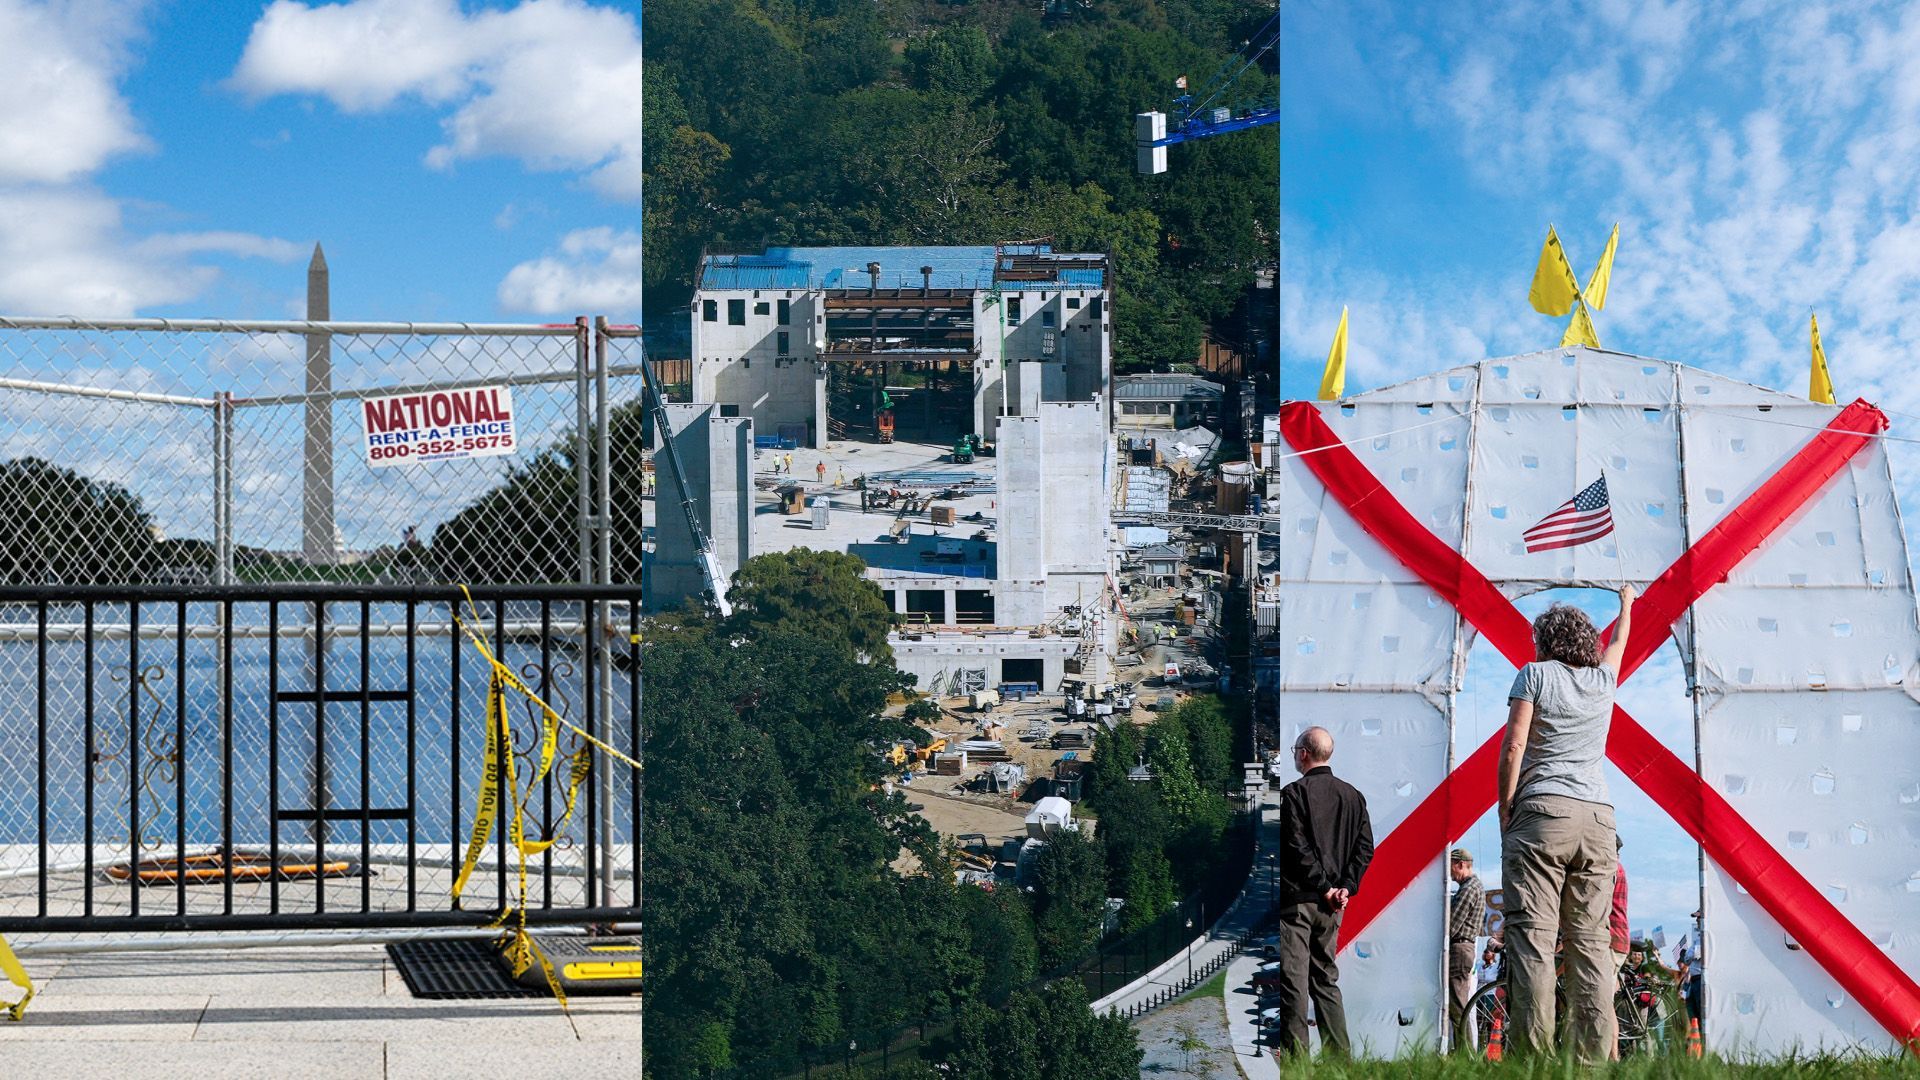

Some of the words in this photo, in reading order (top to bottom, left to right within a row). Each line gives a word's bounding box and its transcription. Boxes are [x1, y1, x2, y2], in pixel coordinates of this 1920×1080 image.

[364, 389, 510, 433] NATIONAL
[369, 421, 511, 446] RENT-A-FENCE
[370, 435, 513, 460] 800-352-5675
